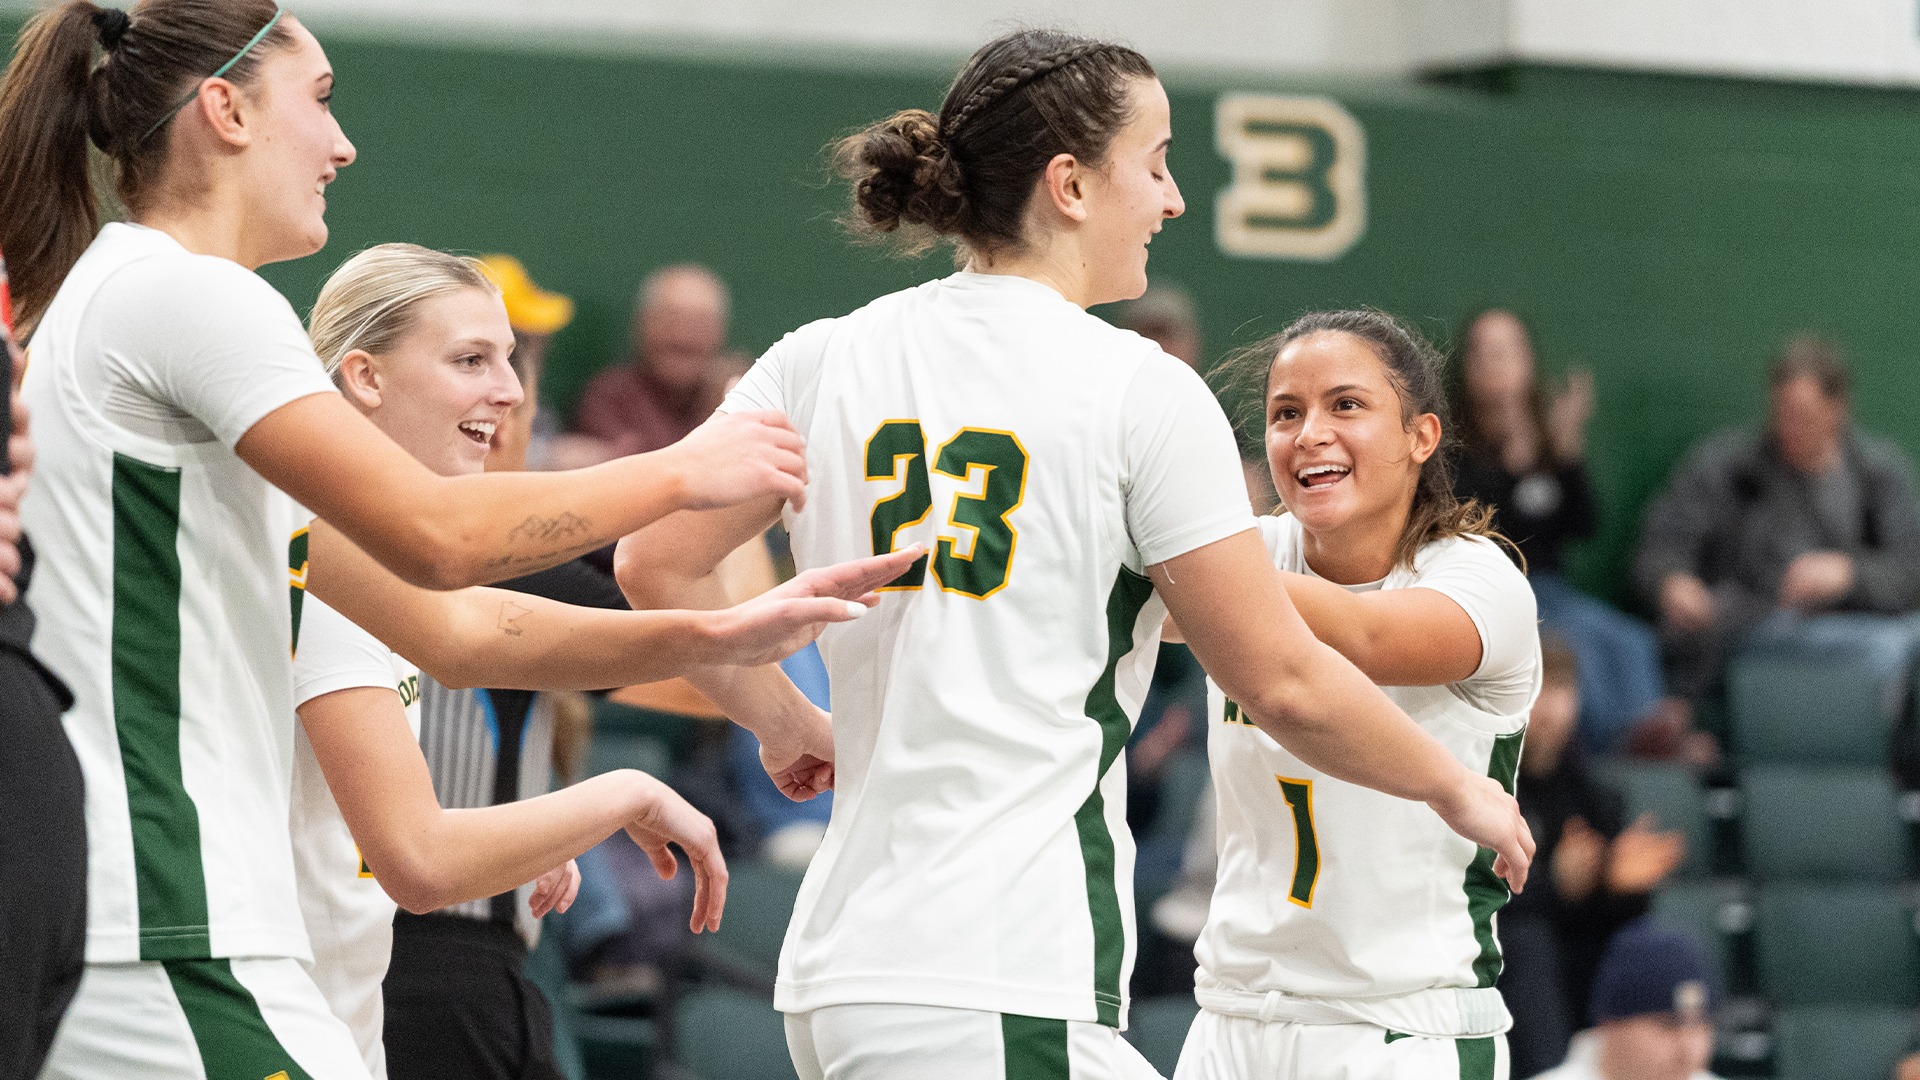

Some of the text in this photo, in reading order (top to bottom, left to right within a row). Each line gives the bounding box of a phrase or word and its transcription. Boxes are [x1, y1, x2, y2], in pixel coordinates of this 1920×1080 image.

[1214, 94, 1367, 261] 3
[864, 418, 1030, 600] 23
[1275, 774, 1321, 910] 1
